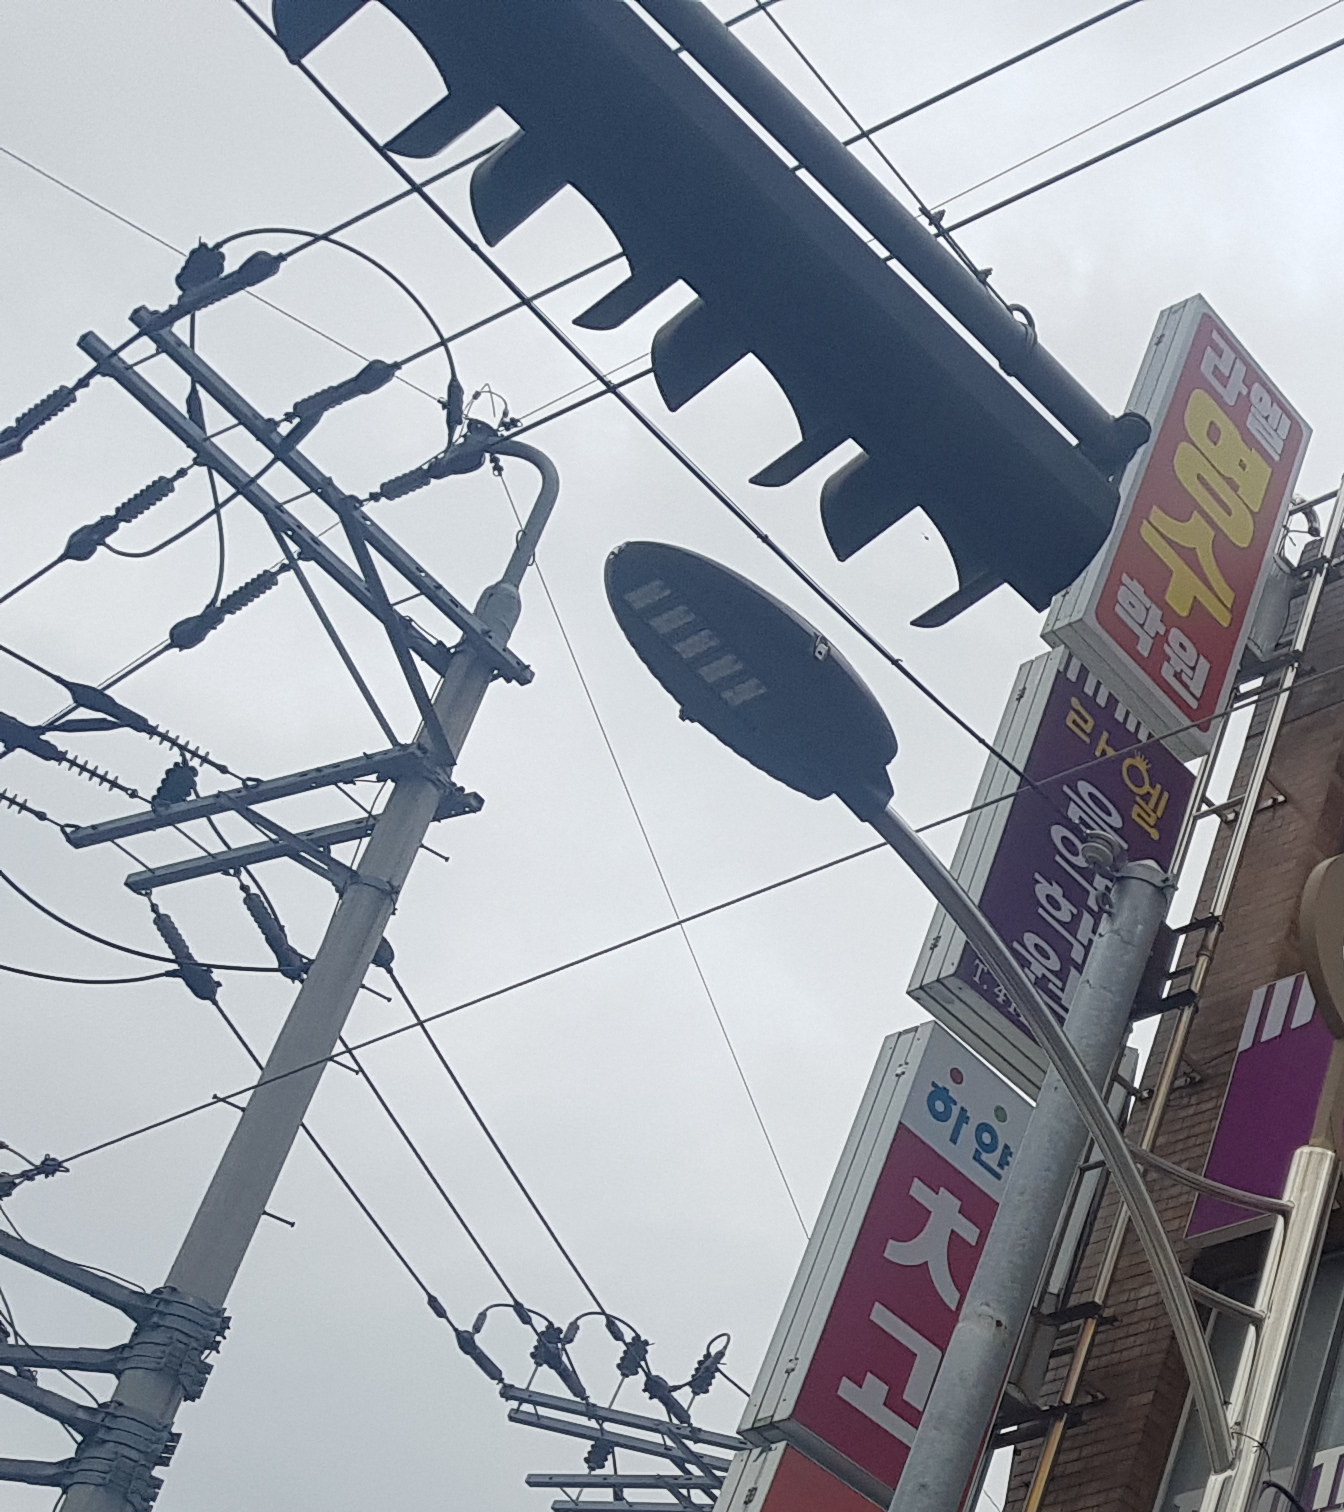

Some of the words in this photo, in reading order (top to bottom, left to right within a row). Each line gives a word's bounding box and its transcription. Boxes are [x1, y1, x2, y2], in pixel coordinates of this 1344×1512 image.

[1200, 328, 1292, 461] 라엘
[1140, 388, 1272, 627] 영수
[1115, 573, 1211, 709] 학원
[1066, 697, 1169, 841] 라엘
